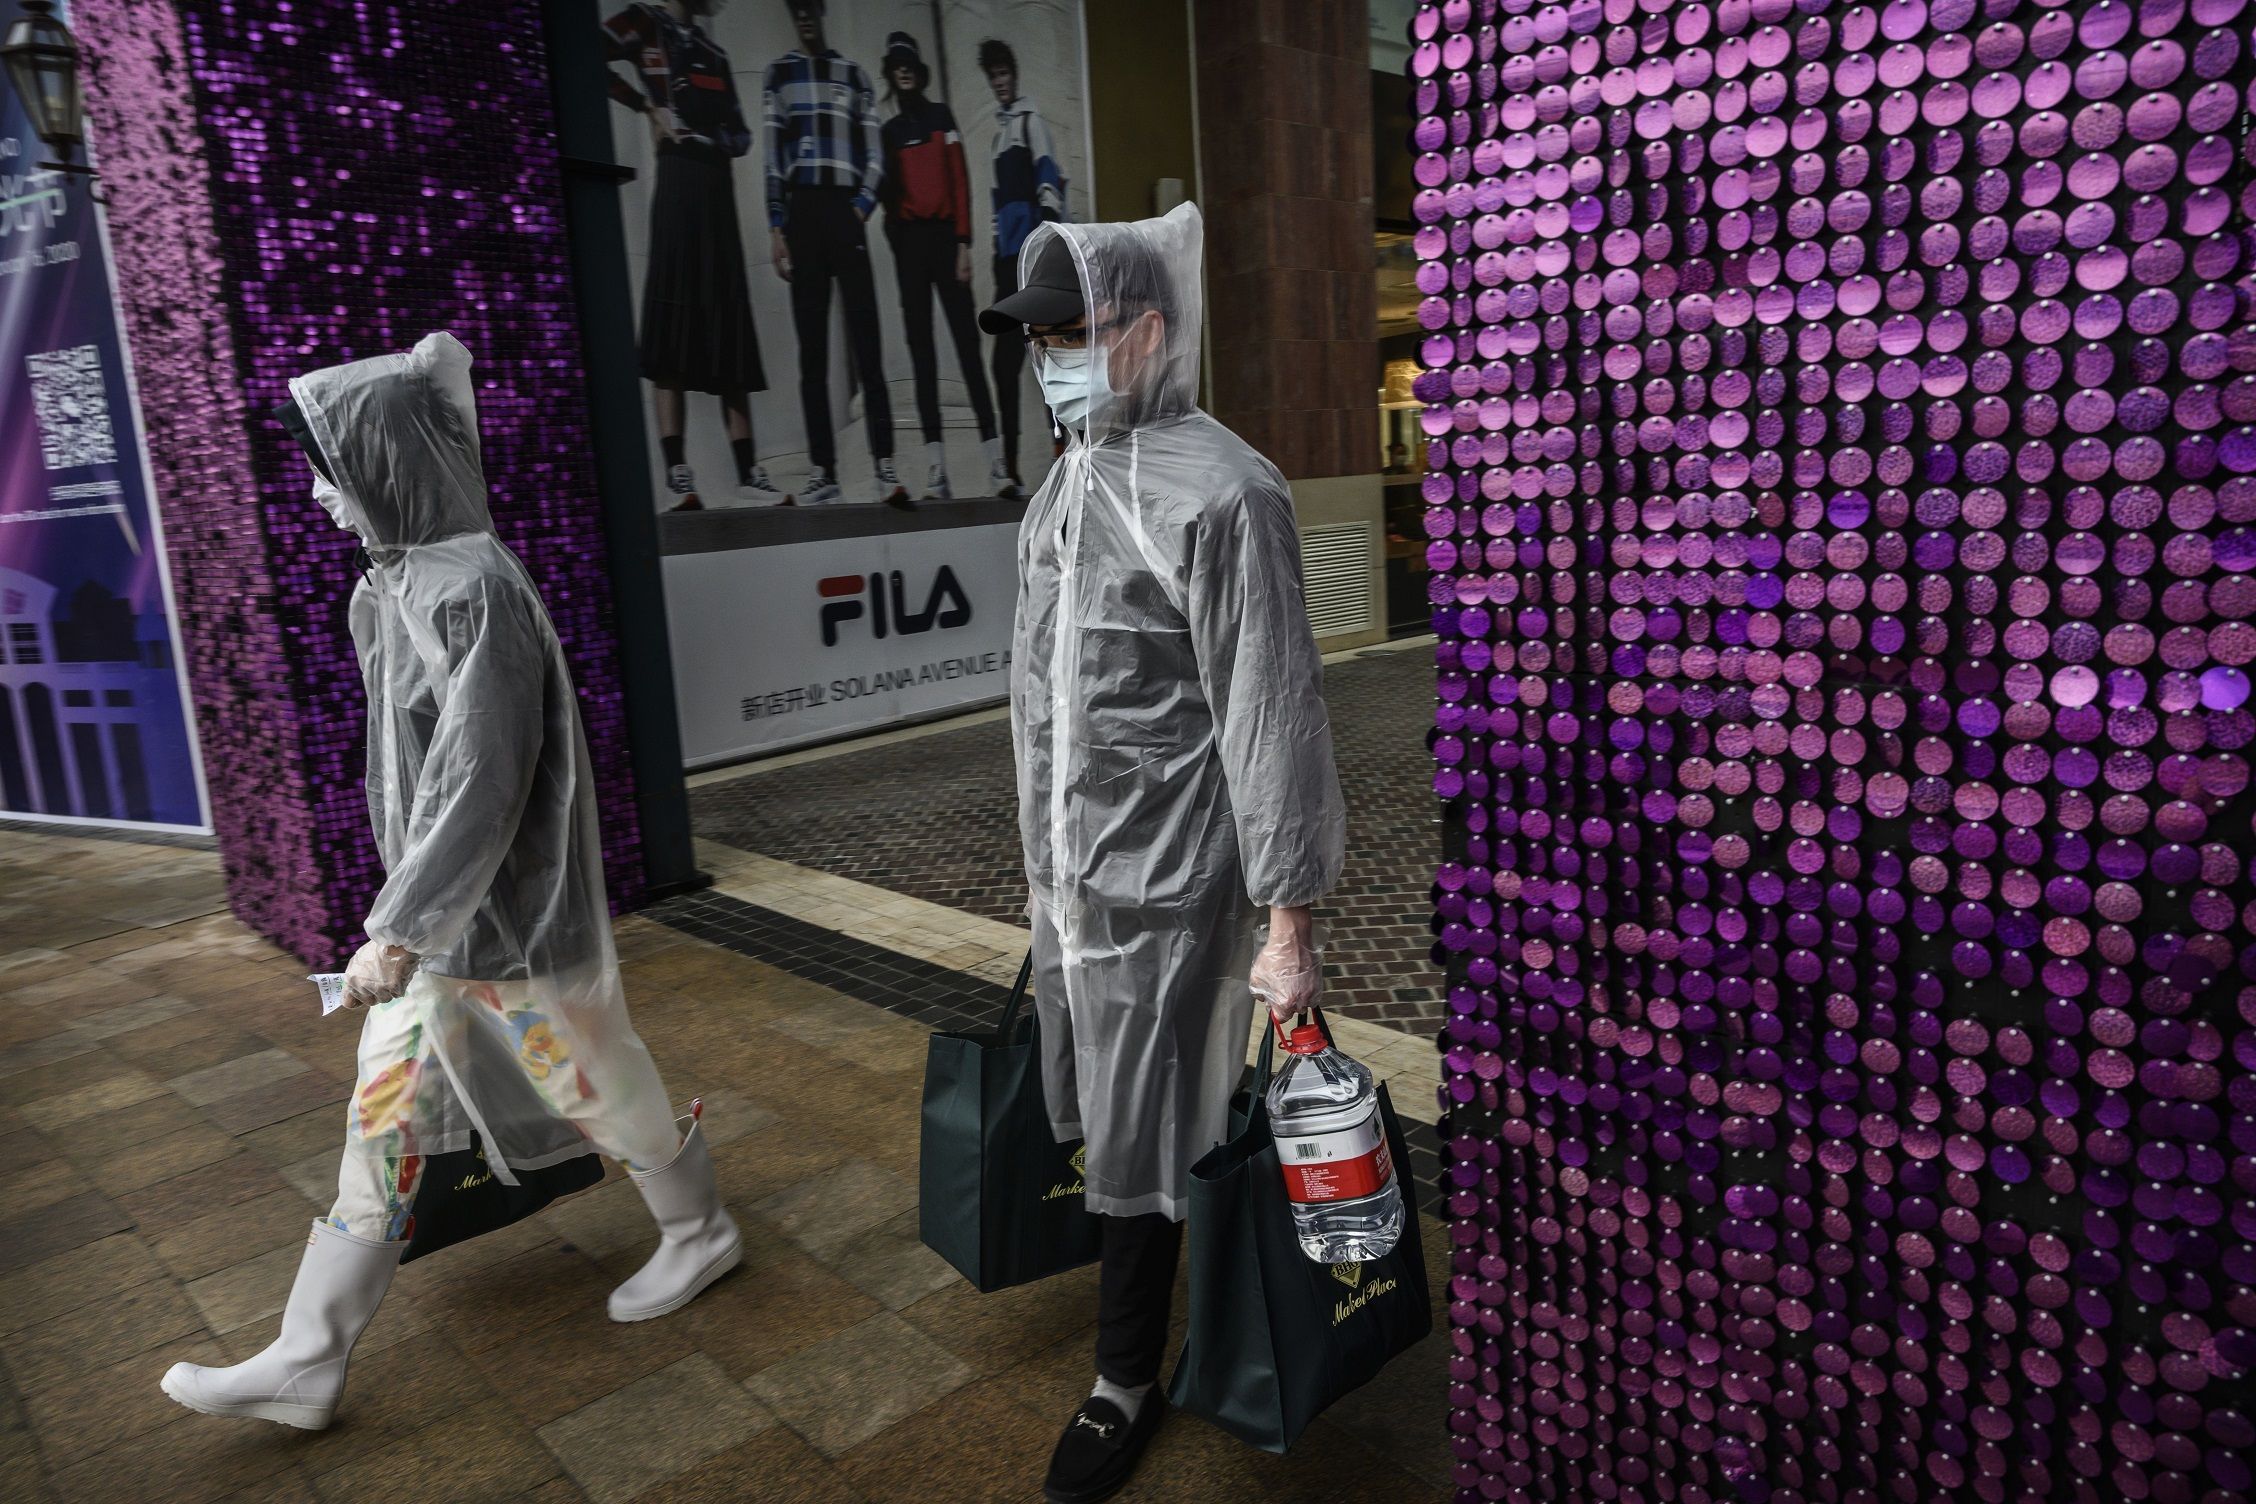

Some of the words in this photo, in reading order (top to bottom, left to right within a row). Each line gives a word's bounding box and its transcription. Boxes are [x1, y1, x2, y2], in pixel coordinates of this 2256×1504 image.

[817, 564, 972, 647] FILA
[830, 667, 916, 702] SOLANA
[917, 652, 999, 684] AVENUE
[741, 684, 828, 722] 新店开业
[454, 1167, 493, 1191] Mark
[1042, 1179, 1086, 1201] Marke
